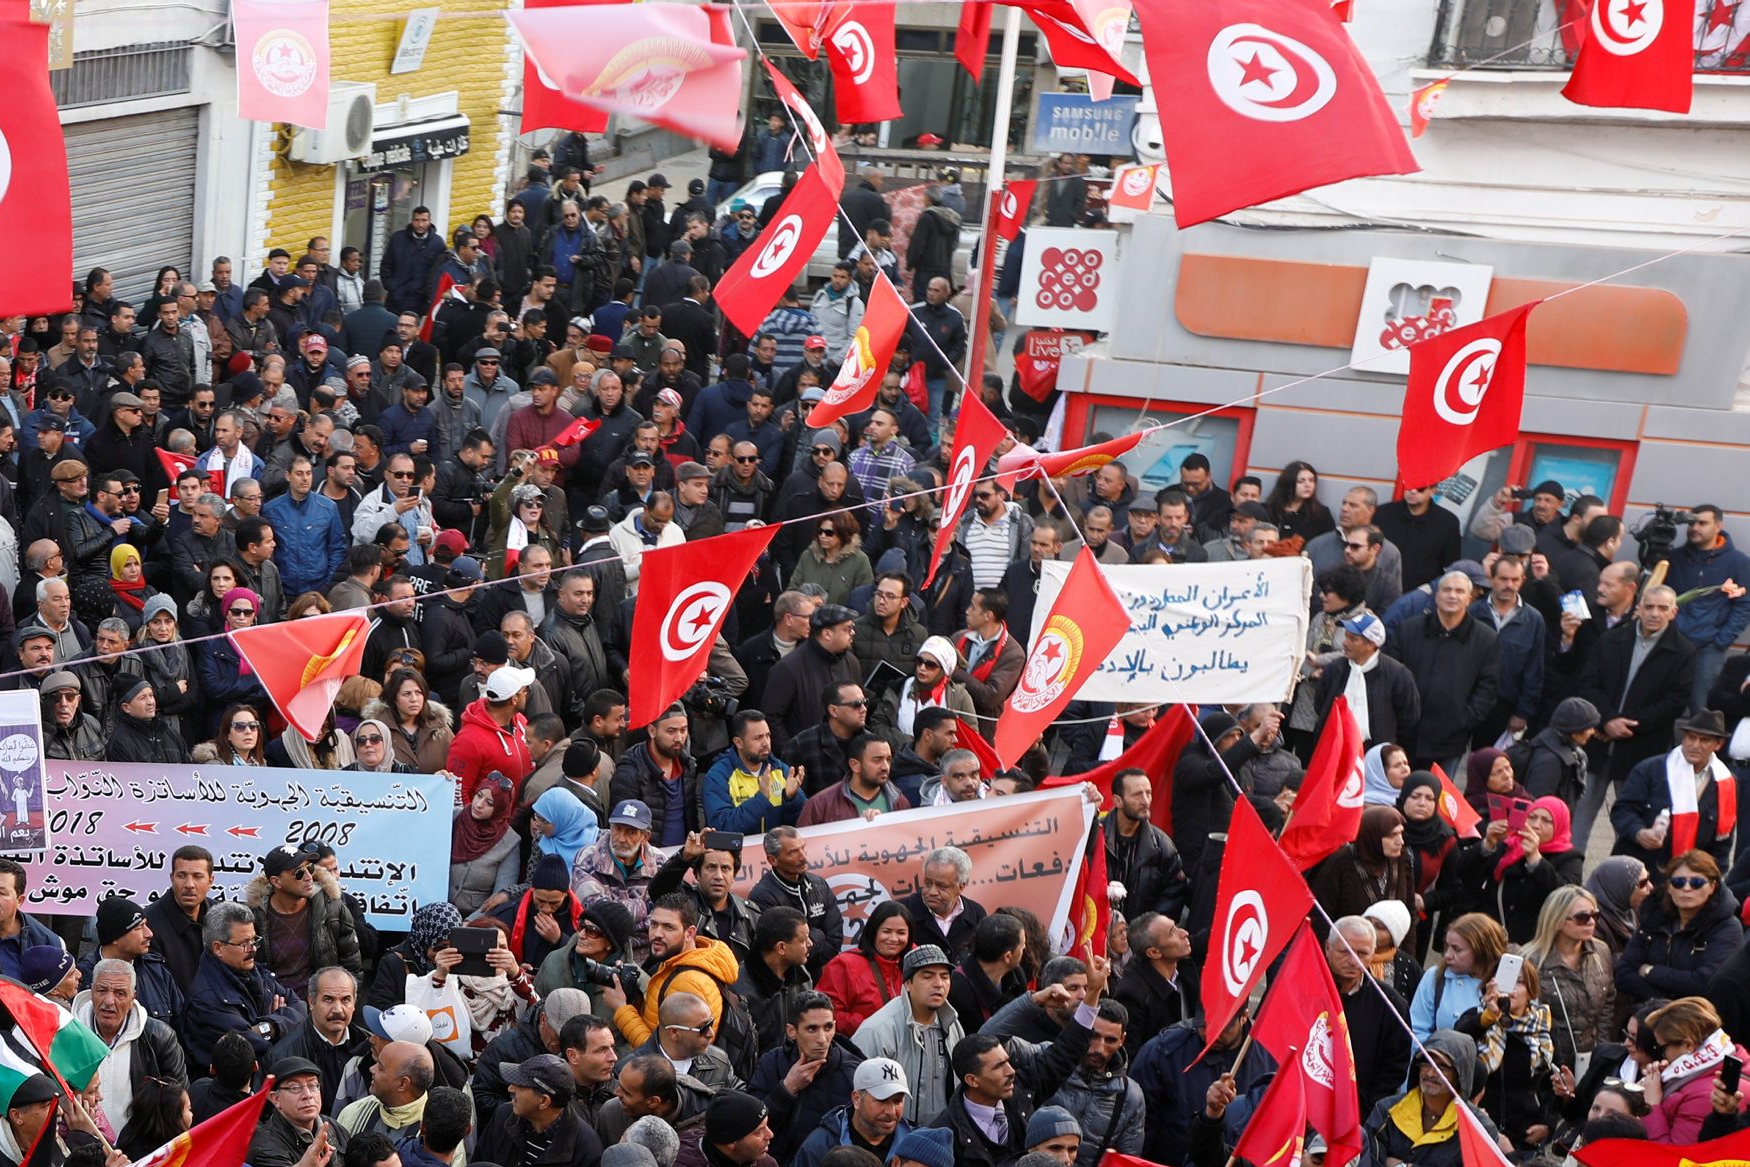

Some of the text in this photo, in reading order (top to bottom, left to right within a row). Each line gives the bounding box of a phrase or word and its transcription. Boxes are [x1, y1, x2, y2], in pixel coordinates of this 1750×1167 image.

[1052, 106, 1123, 120] SAMSUNG
[48, 810, 357, 846] 2008 018
[28, 874, 88, 903] موش
[881, 1063, 901, 1081] NY
